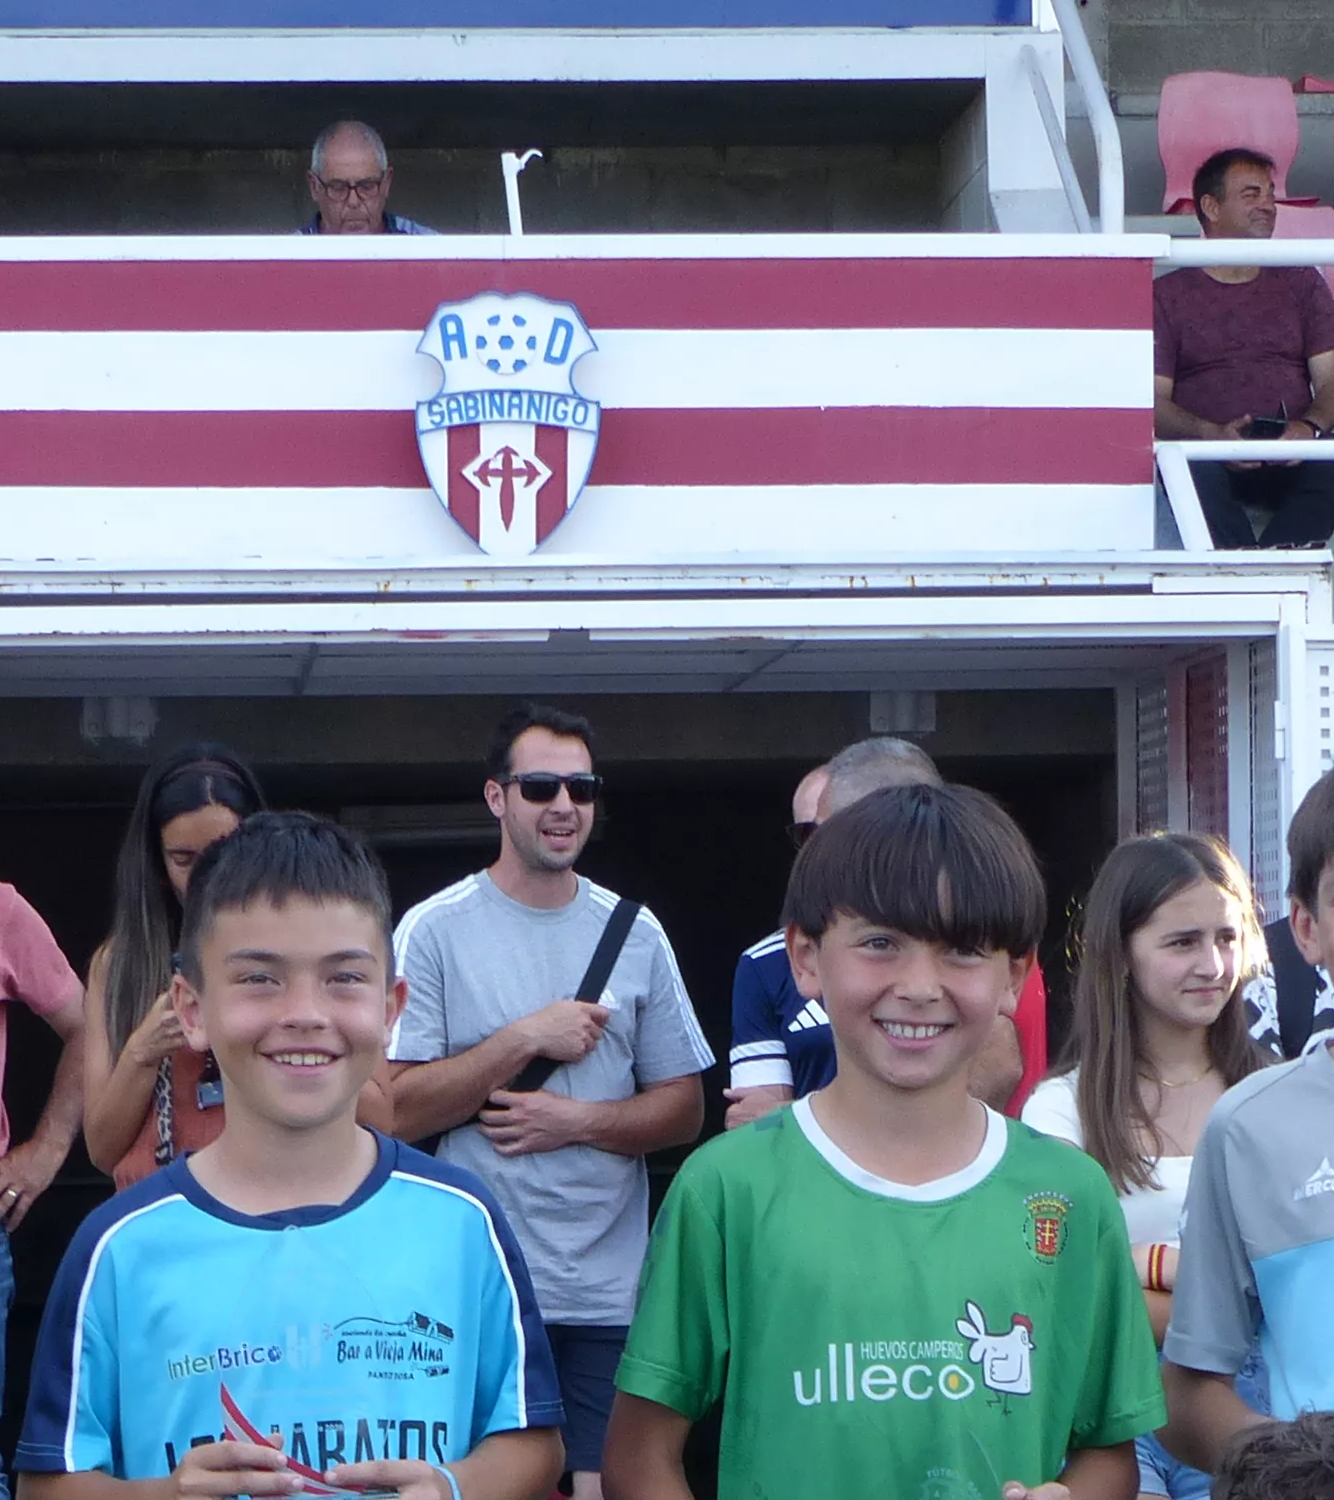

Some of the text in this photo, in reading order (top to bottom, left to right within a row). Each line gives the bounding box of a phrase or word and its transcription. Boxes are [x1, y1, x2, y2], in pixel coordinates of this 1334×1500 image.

[439, 314, 574, 365] A D
[337, 1340, 360, 1364] Bar
[375, 1340, 404, 1364] Vieja
[408, 1341, 444, 1361] Mina
[793, 1343, 975, 1406] ulleco
[860, 1340, 964, 1361] HUEVOS CAMPEROS
[270, 1418, 448, 1473] ARATOS
